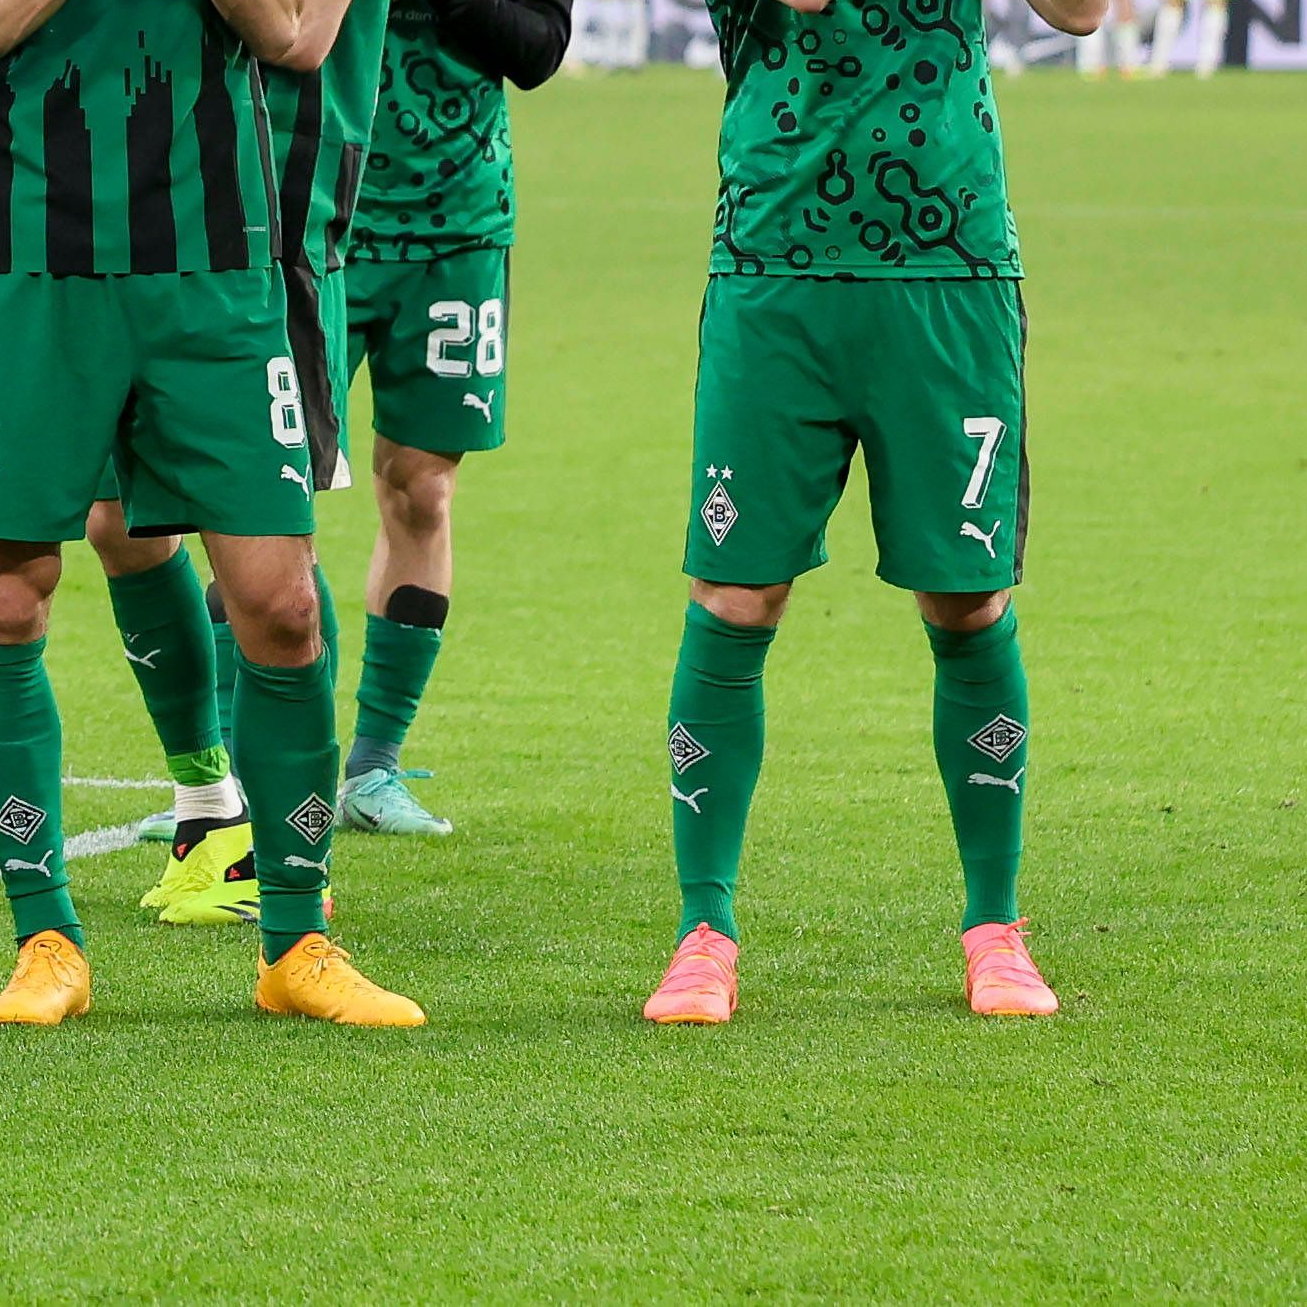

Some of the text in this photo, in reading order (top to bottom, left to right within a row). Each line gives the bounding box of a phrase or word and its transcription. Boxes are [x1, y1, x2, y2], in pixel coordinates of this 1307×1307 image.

[426, 298, 505, 378] 28
[266, 356, 308, 449] 8
[961, 416, 1007, 509] 7
